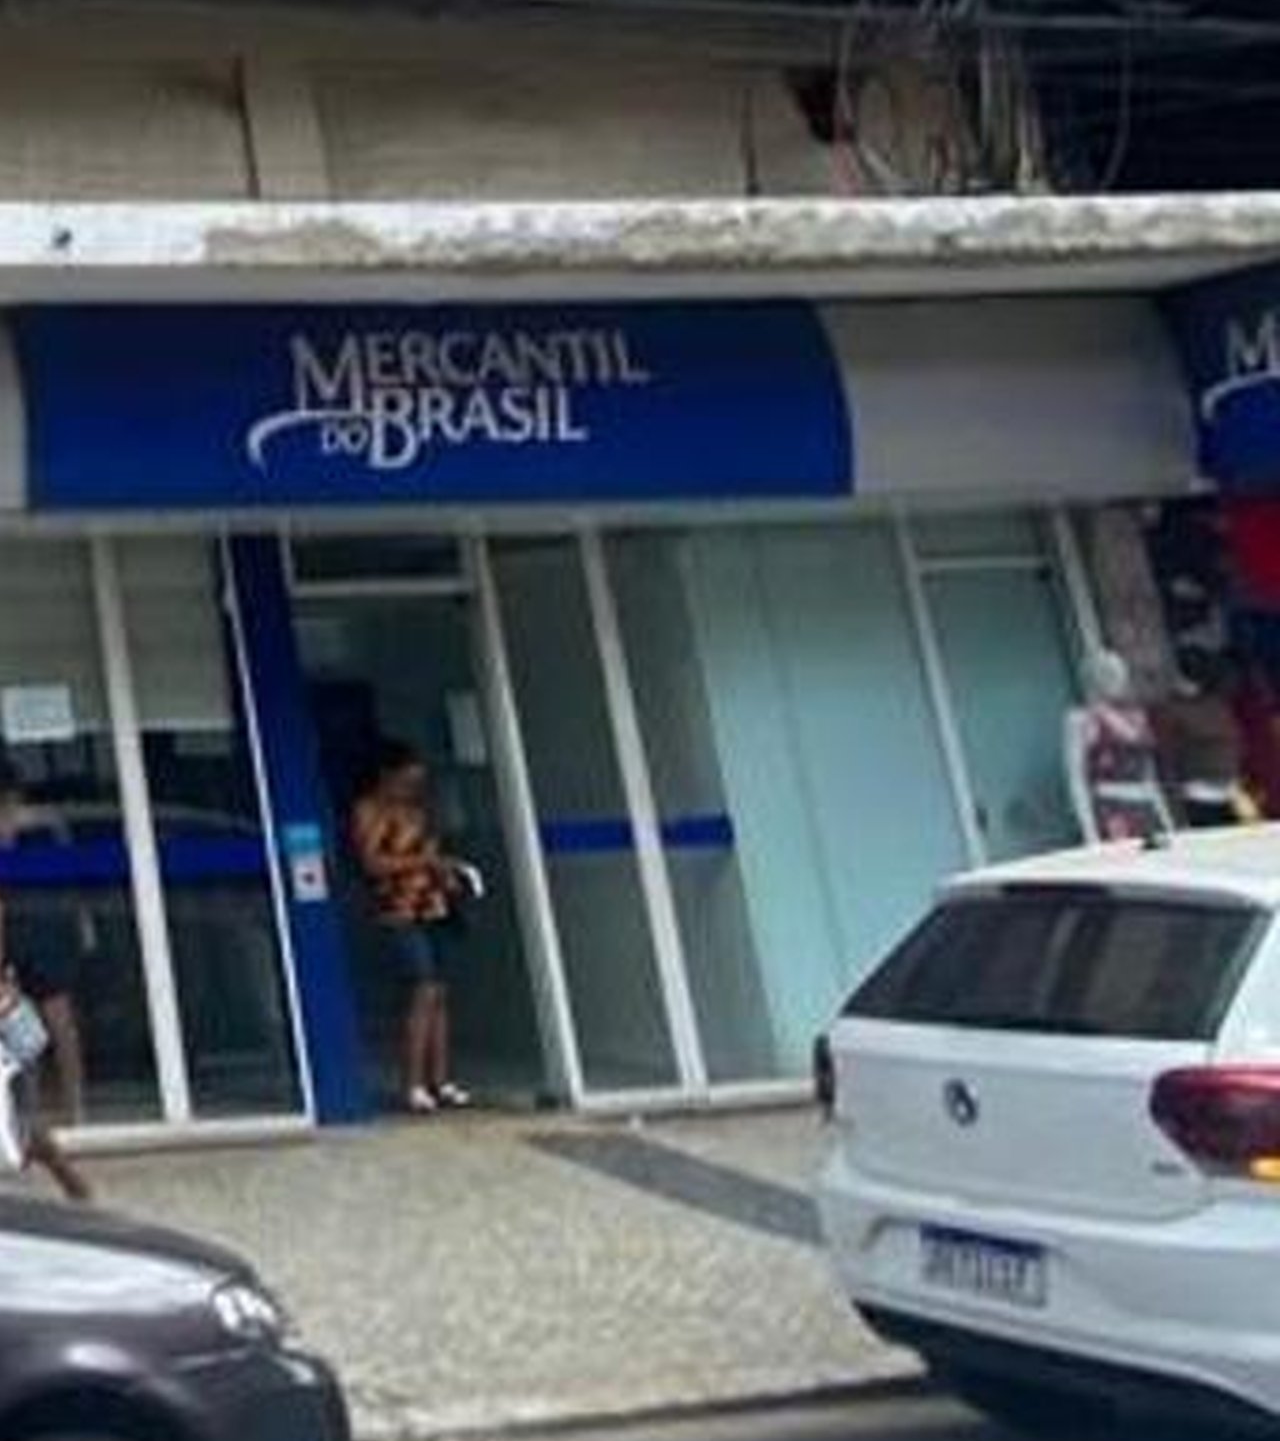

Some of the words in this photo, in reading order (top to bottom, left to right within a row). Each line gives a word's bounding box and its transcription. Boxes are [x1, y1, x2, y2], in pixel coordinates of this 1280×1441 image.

[290, 329, 649, 416] MERCANTIL
[321, 421, 368, 455] DO
[368, 388, 587, 468] BRASIL
